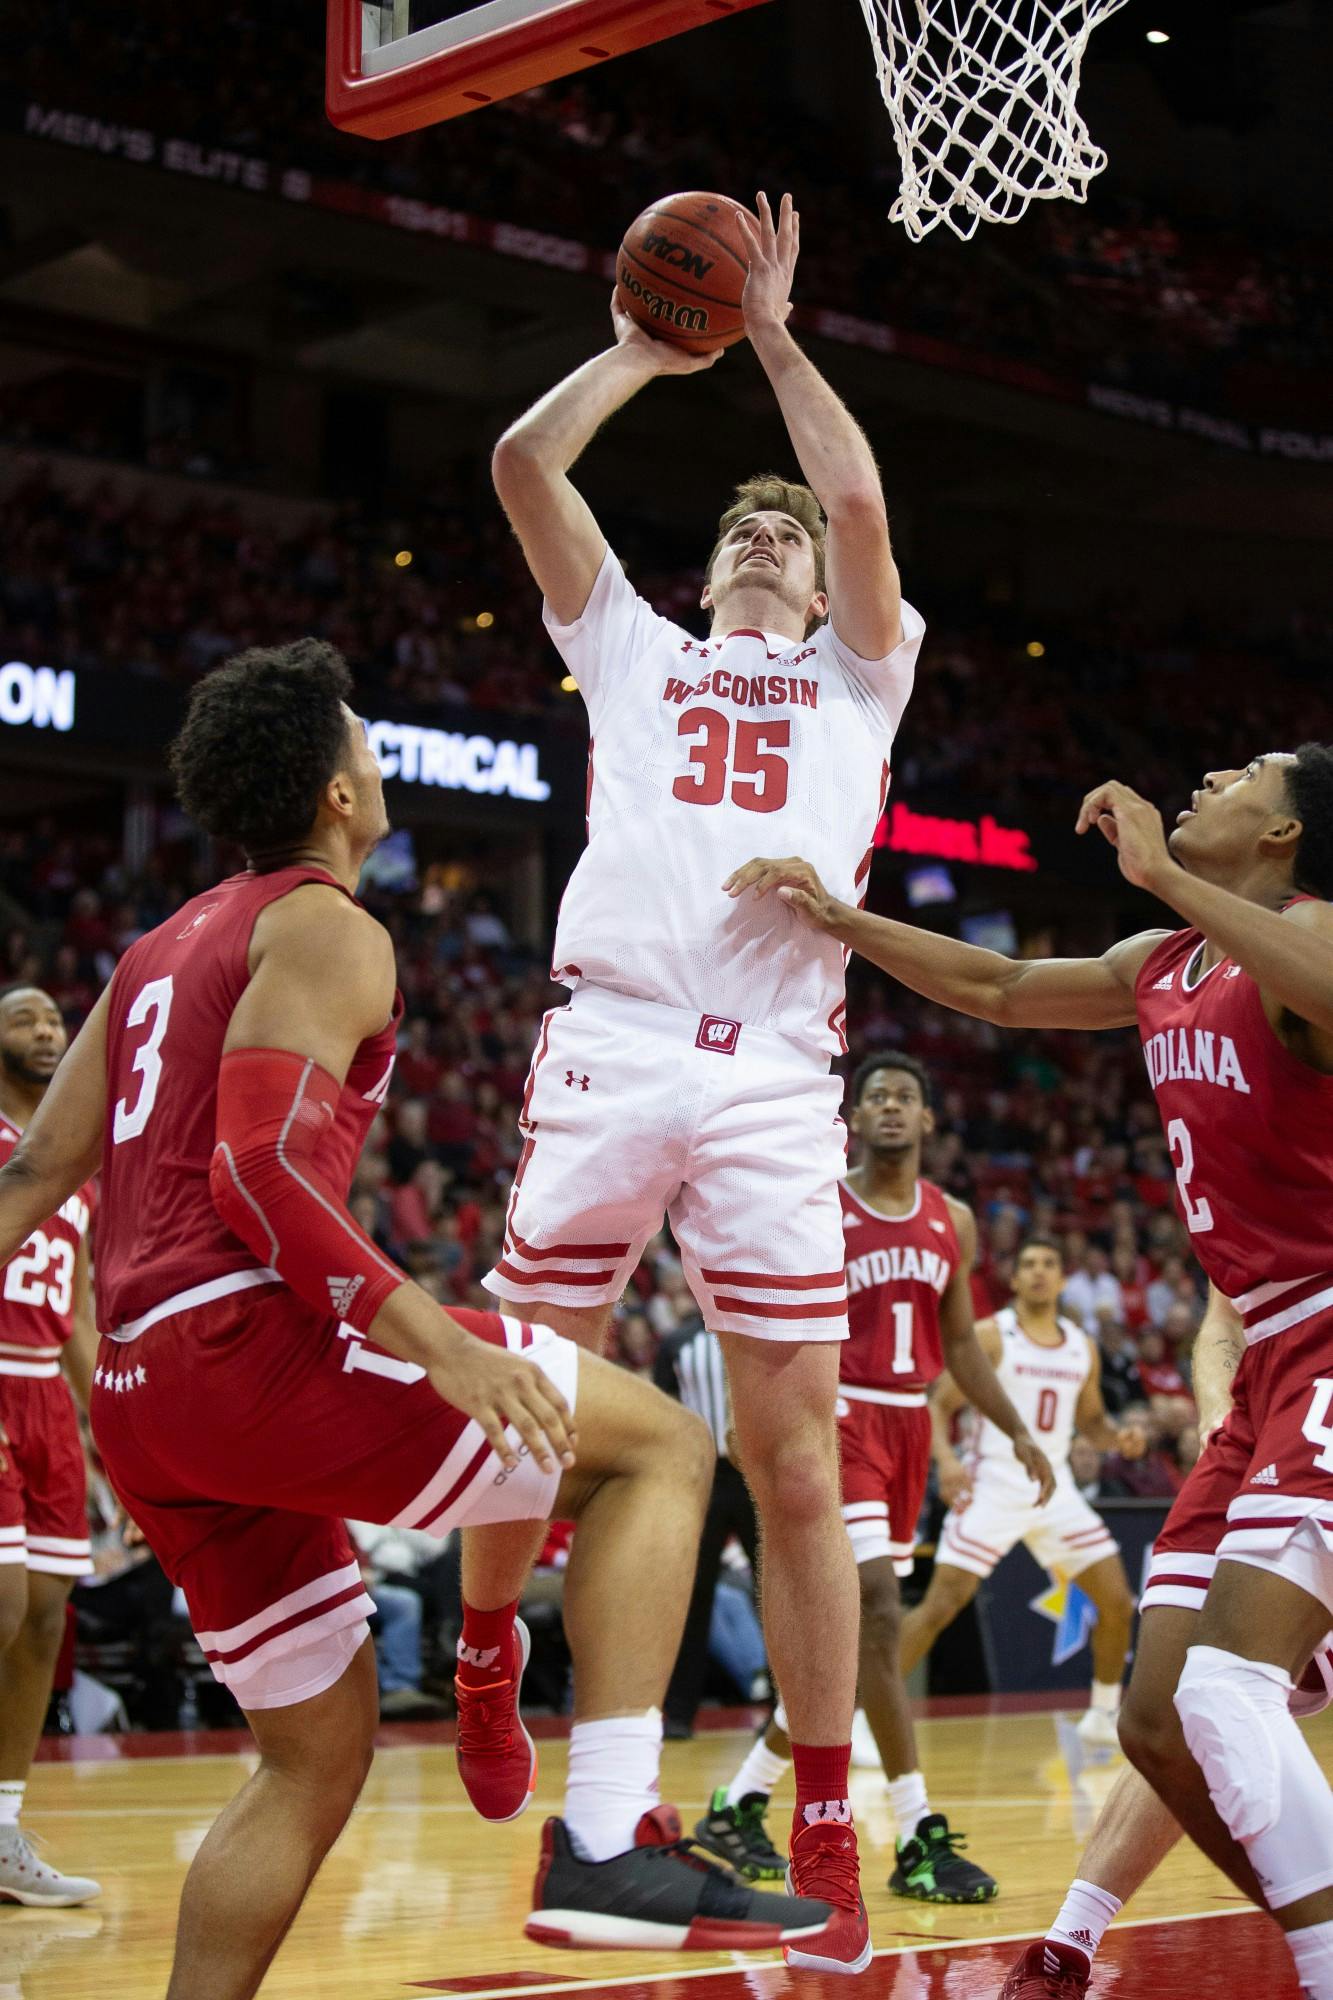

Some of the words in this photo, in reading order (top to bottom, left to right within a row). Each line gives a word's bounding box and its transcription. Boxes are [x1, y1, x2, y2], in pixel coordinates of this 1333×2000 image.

[642, 231, 715, 281] NCAA
[620, 264, 710, 332] Wilson
[663, 669, 819, 710] WSCONSIN
[364, 719, 551, 801] CTRICAL
[672, 706, 790, 814] 35
[113, 974, 173, 1145] 3
[1143, 1027, 1251, 1095] NDIANA
[1167, 1117, 1214, 1234] 2
[3, 1229, 75, 1317] 23
[892, 1302, 915, 1374] 1
[1037, 1388, 1058, 1432] 0
